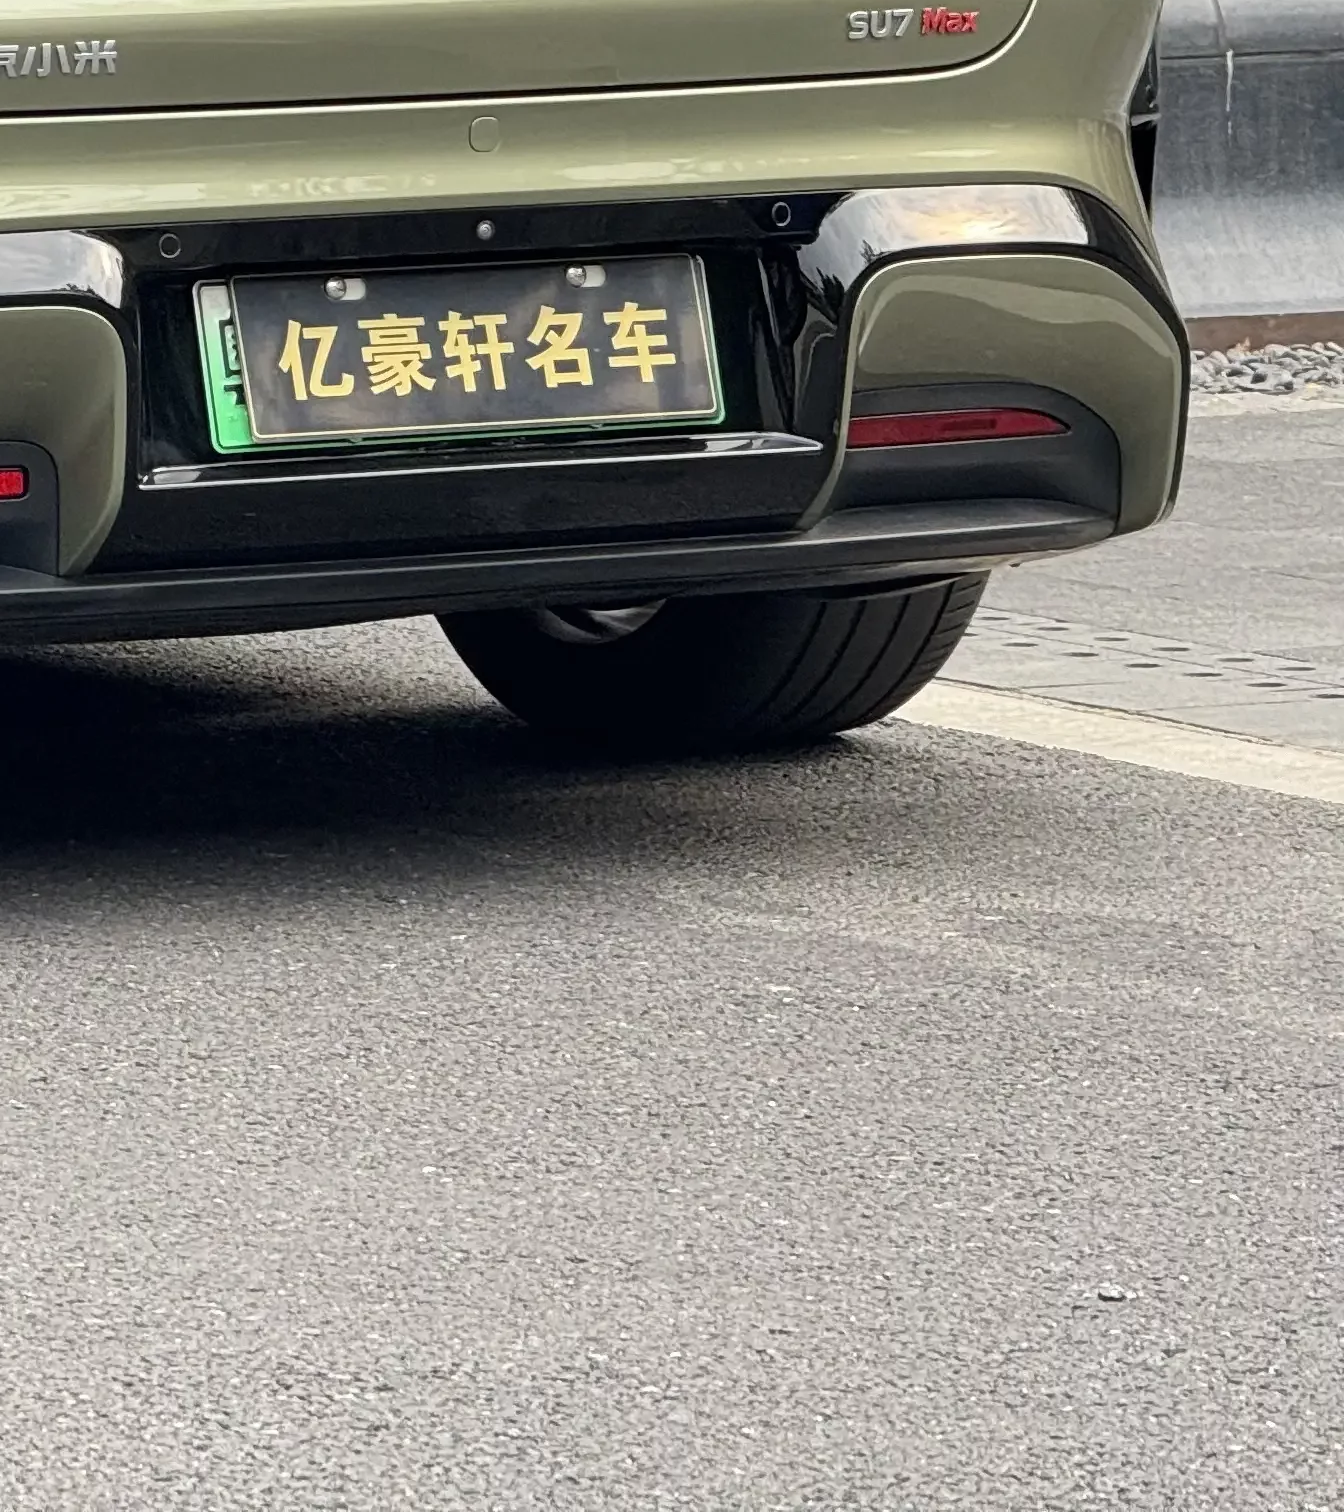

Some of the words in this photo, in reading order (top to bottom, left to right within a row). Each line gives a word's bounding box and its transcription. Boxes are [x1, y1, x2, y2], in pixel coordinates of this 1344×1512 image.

[847, 8, 914, 40] SU7
[921, 6, 980, 35] Max
[278, 301, 677, 402] 亿豪轩名车
